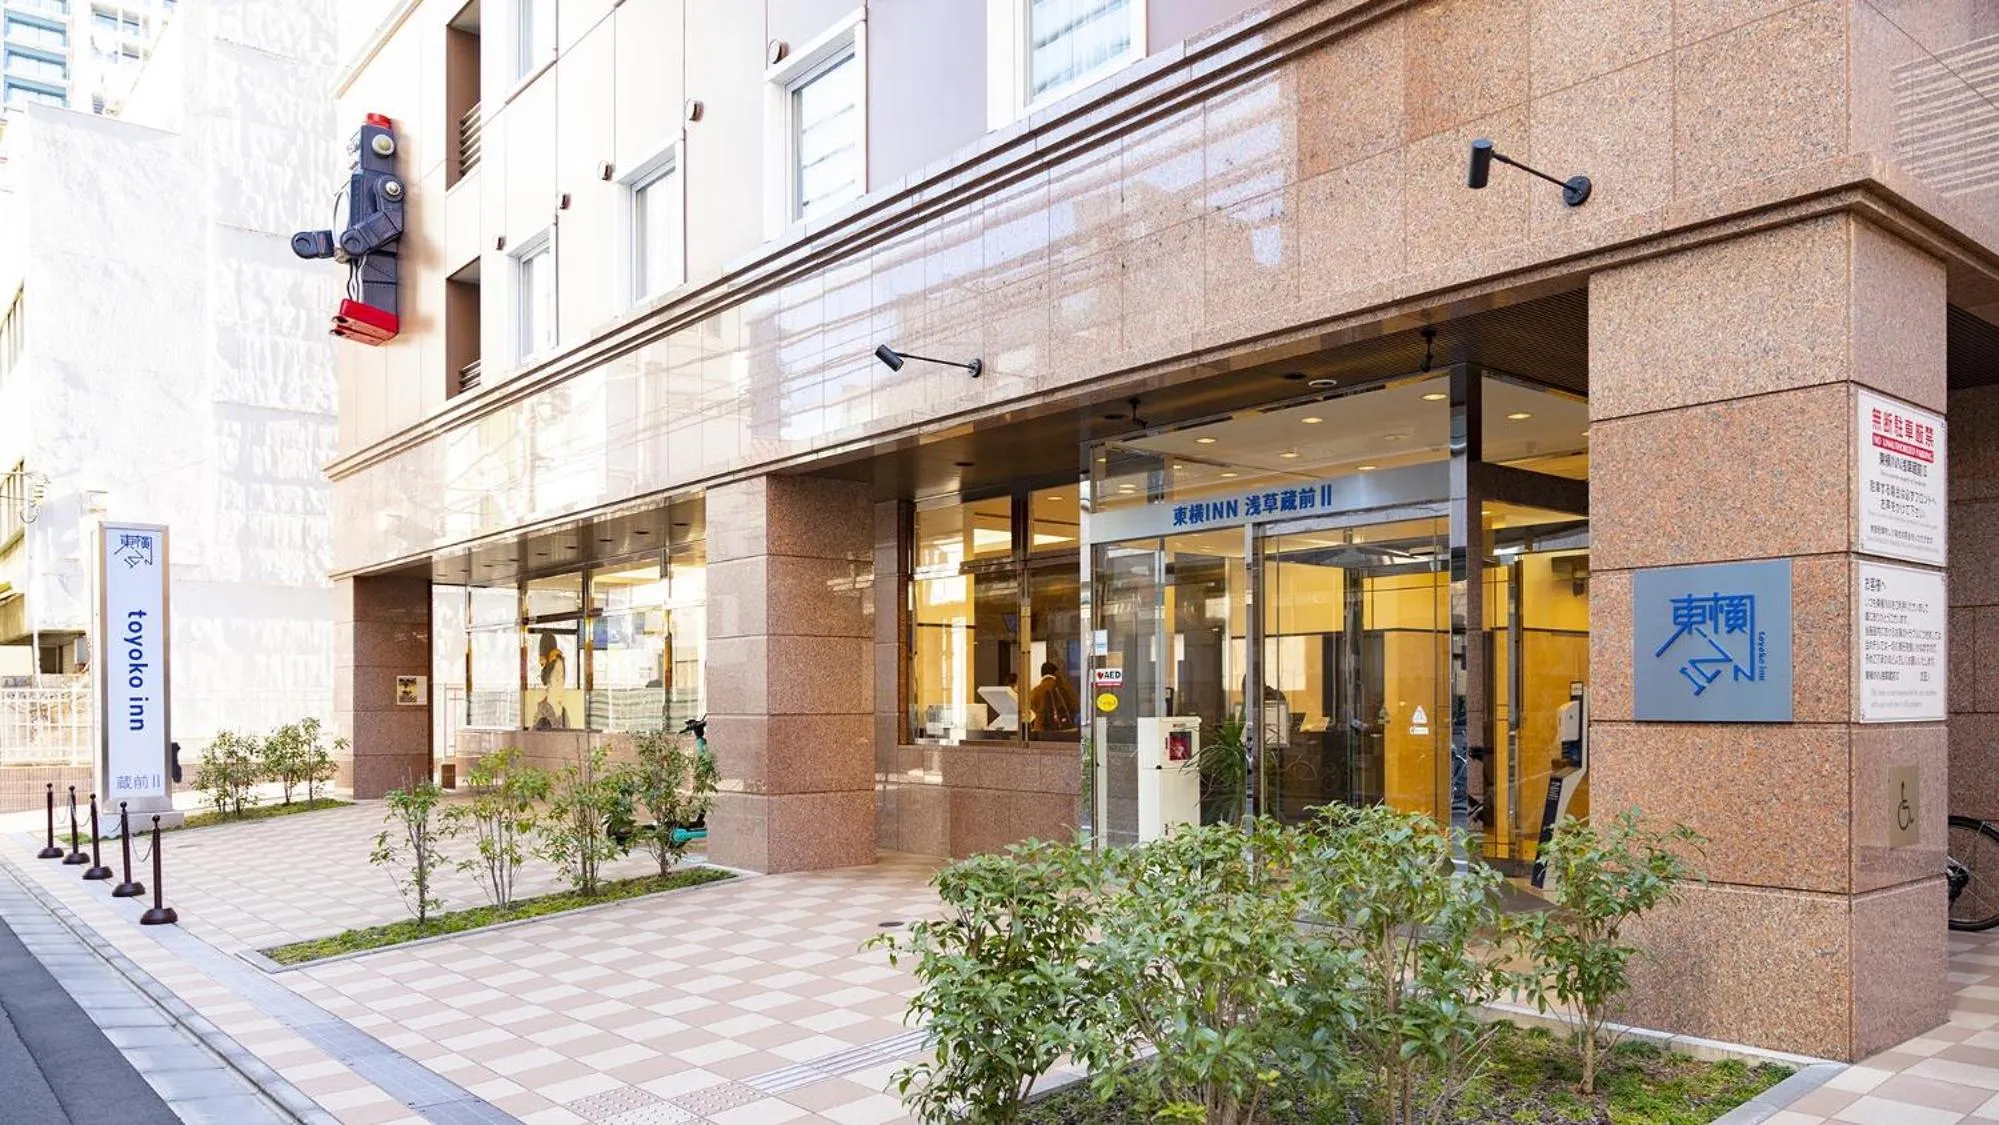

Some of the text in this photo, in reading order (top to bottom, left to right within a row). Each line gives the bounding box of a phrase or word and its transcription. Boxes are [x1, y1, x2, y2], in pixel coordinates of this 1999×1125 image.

[1173, 499, 1239, 526] 東横INN
[123, 609, 149, 731] toyoko inn
[1104, 670, 1122, 680] AED
